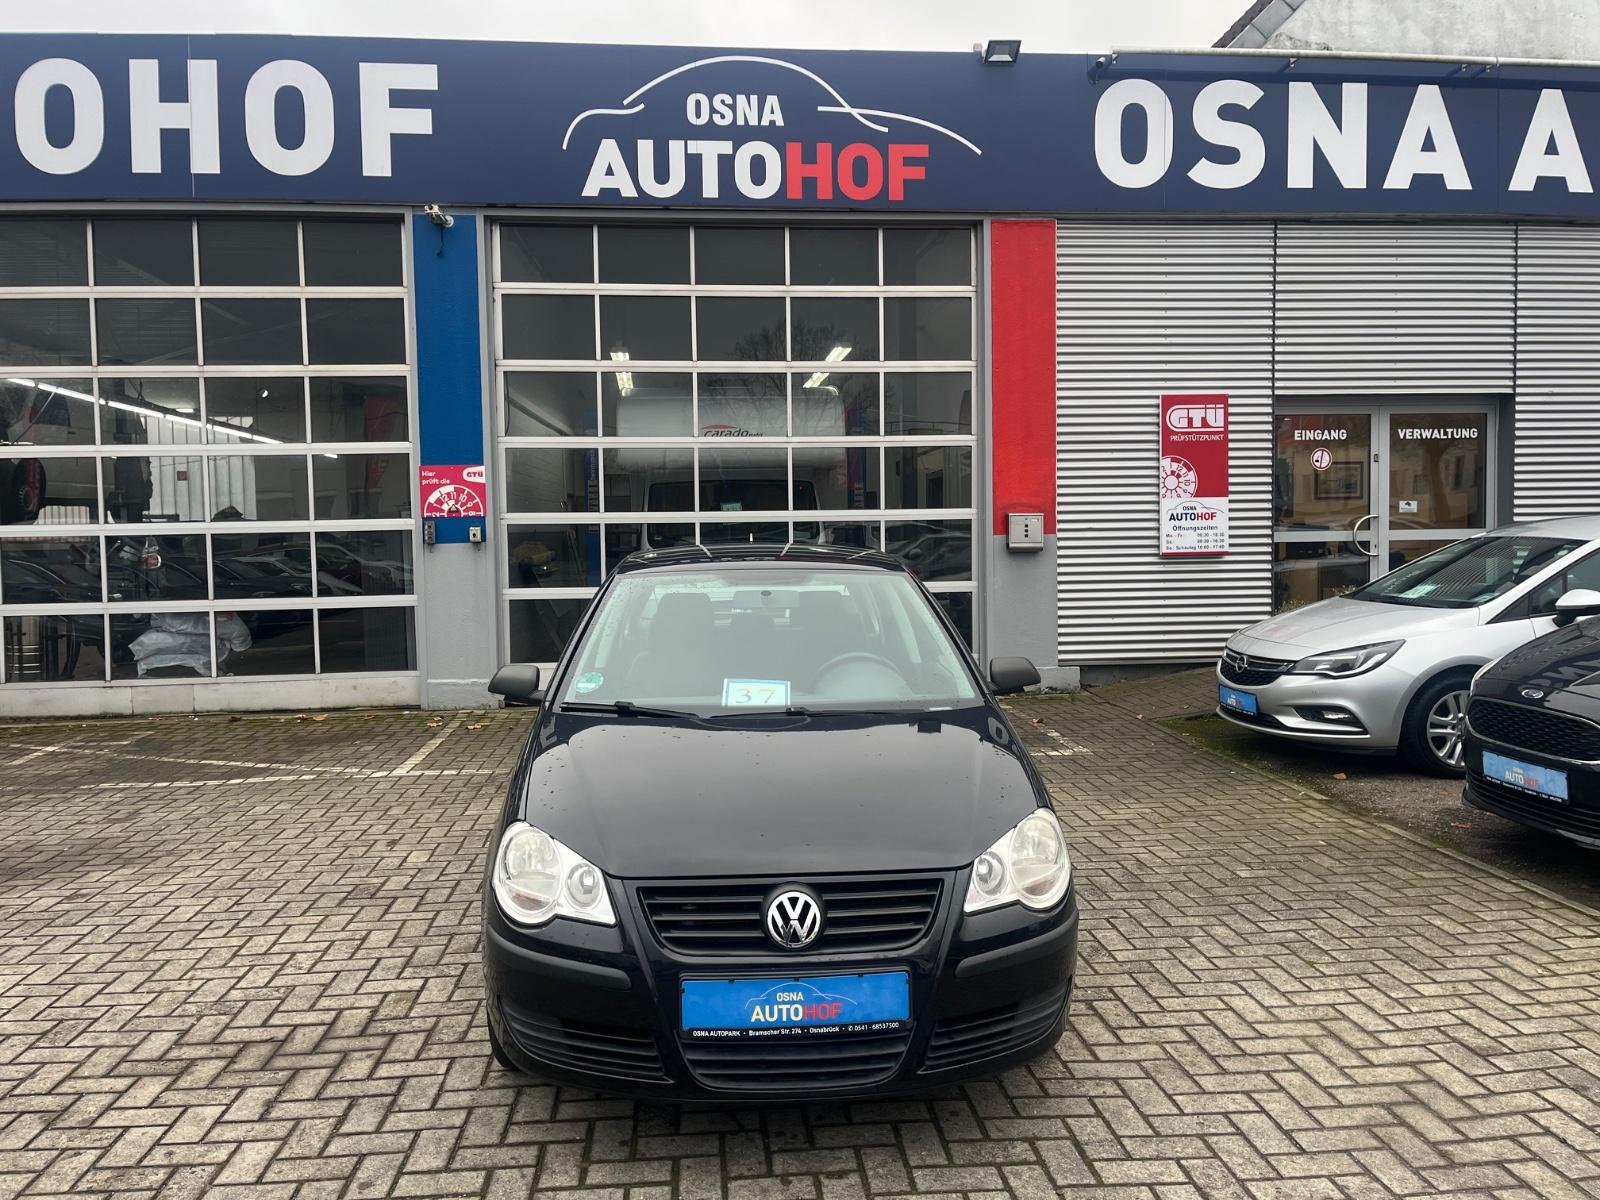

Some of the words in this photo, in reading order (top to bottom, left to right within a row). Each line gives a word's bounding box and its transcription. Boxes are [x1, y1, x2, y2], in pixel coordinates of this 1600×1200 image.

[686, 92, 785, 128] OSNA
[14, 58, 439, 178] OHOF
[1093, 79, 1473, 190] OSNA
[1508, 88, 1595, 194] A
[581, 138, 930, 202] AUTOHOF
[1168, 404, 1225, 429] GTÜ
[1294, 429, 1347, 441] EINGANG
[1397, 428, 1479, 440] VERWALTUNG
[440, 494, 448, 503] 12
[459, 493, 467, 502] 10
[1168, 512, 1217, 522] AUTOHOF
[1172, 524, 1218, 532] Öffnungszeiten
[776, 991, 804, 1002] OSNA
[750, 1001, 844, 1023] AUTOHOF
[809, 1026, 840, 1034] Osnabrück
